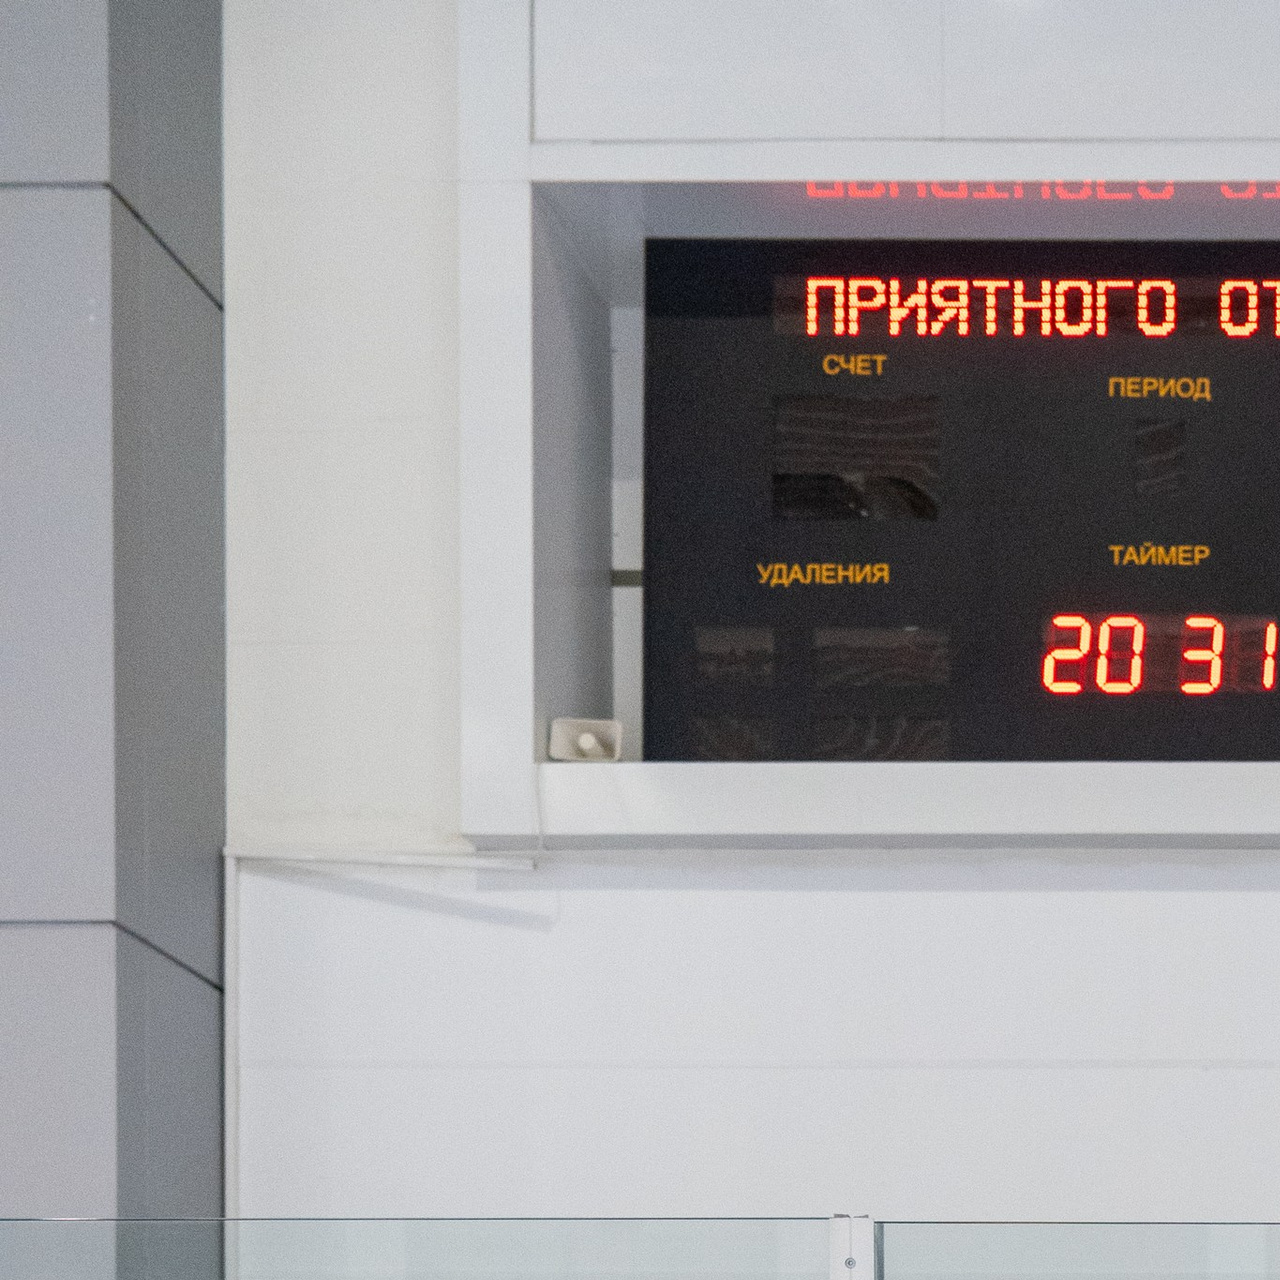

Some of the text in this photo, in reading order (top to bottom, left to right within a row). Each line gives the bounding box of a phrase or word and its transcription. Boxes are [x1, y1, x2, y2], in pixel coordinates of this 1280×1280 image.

[805, 277, 1177, 338] ПРИЯТНОГО
[822, 354, 887, 375] СЧЕТ
[1108, 376, 1212, 400] ПЕРИОД
[1109, 543, 1210, 566] ТАЙМЕР
[758, 563, 890, 587] УДАЛЕНИЯ
[1042, 614, 1277, 694] 20 31
